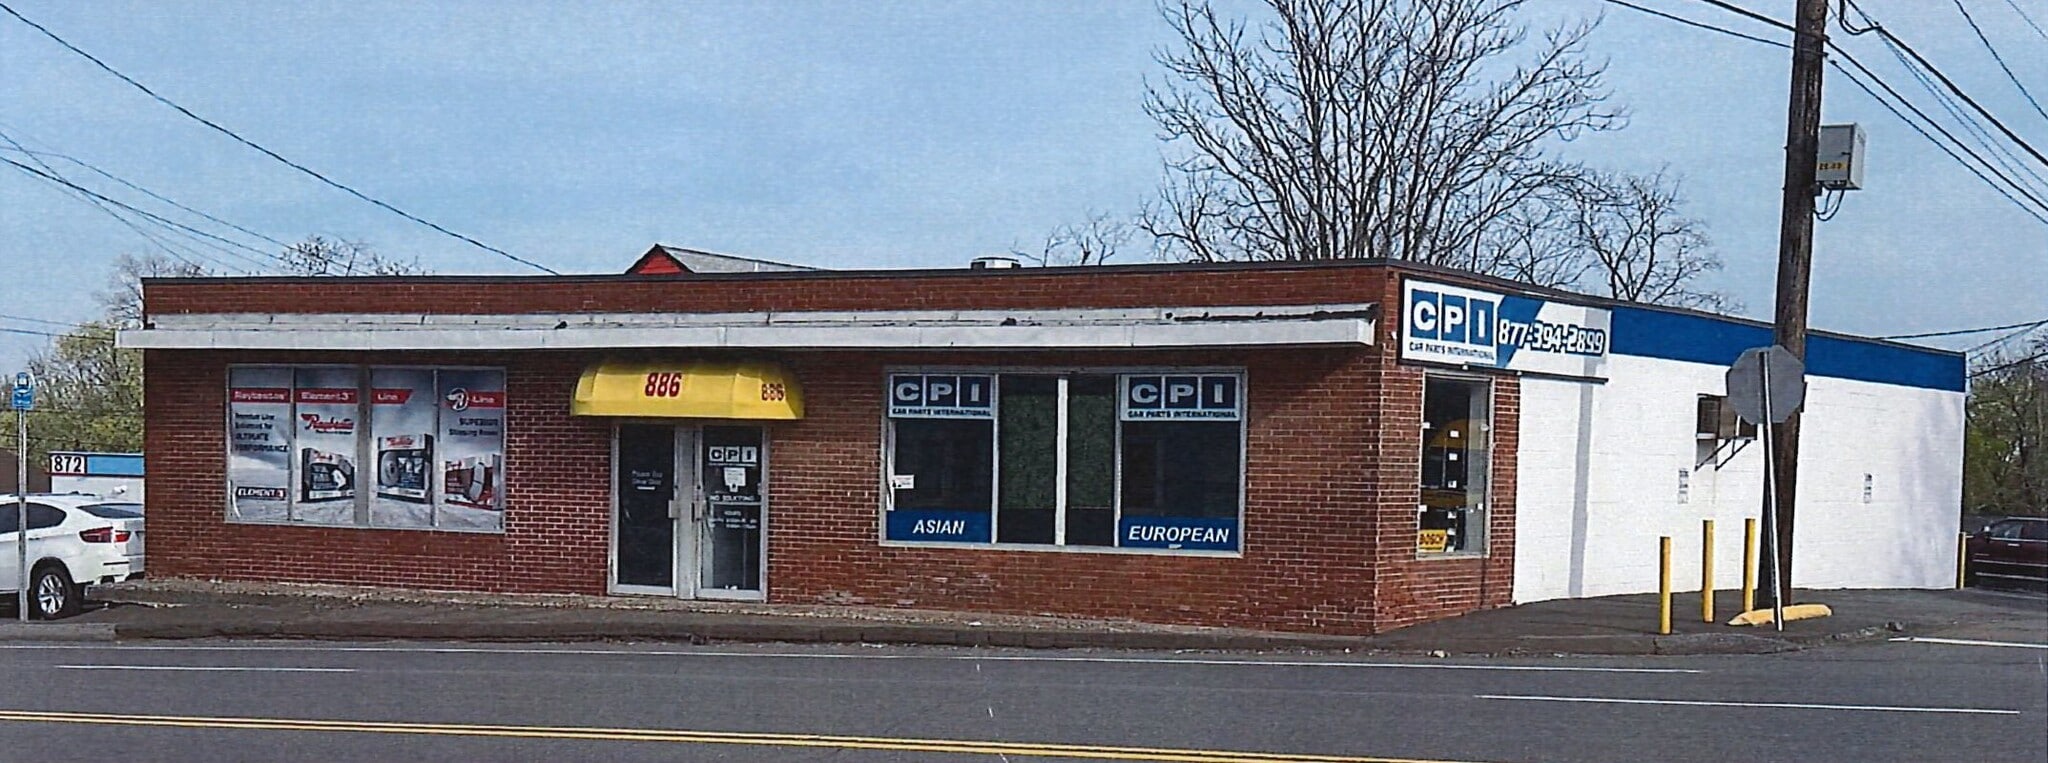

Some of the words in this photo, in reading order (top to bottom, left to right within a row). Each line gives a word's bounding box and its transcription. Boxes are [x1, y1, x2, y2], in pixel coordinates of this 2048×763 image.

[1412, 299, 1487, 339] CPI
[1498, 318, 1605, 355] 877-394-2899
[1409, 341, 1424, 352] CAR
[1425, 343, 1446, 354] PARTS
[644, 372, 682, 397] 886
[761, 383, 785, 401] 886
[894, 381, 982, 403] CPI
[1130, 382, 1225, 405] CPI
[377, 392, 399, 401] Line
[1128, 410, 1144, 418] CAR
[710, 448, 754, 461] CPI
[53, 455, 82, 473] 872
[912, 519, 965, 535] ASIAN
[1128, 525, 1230, 544] EUROPEAN
